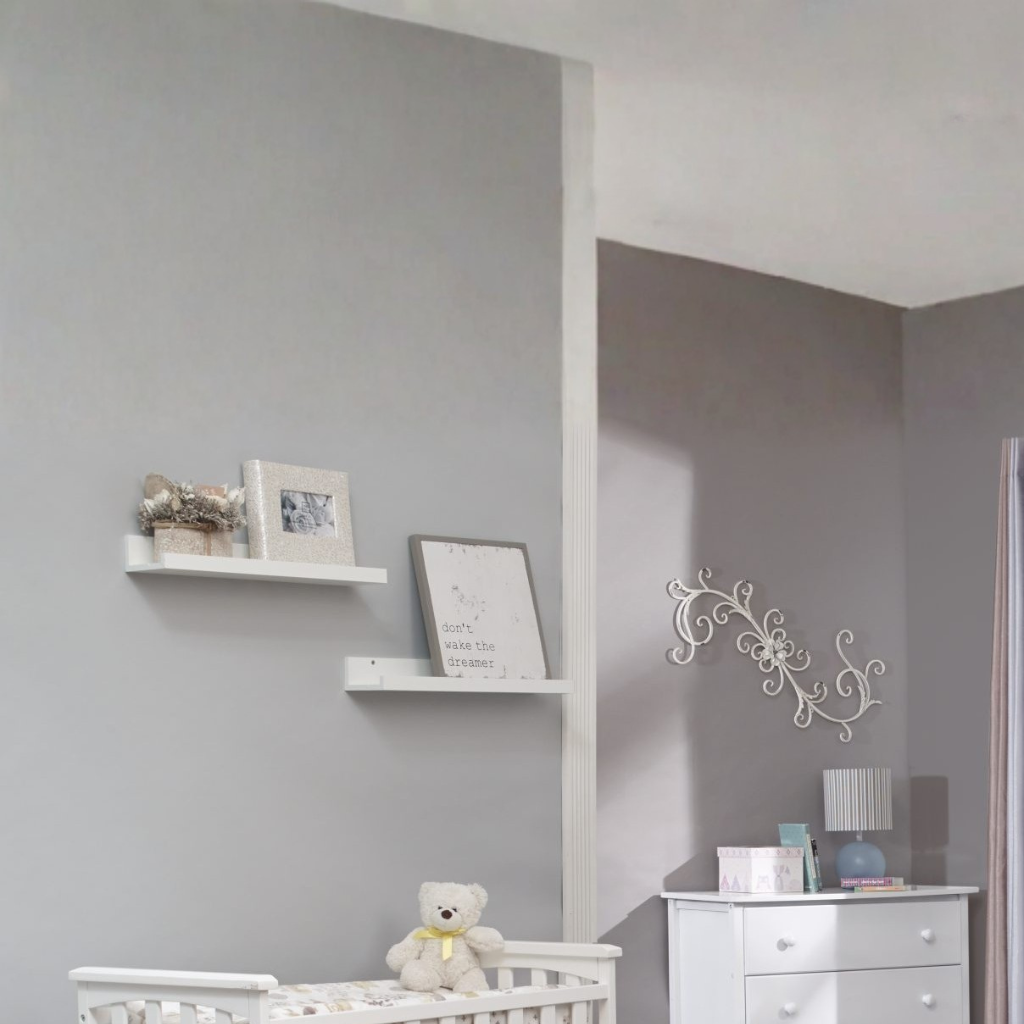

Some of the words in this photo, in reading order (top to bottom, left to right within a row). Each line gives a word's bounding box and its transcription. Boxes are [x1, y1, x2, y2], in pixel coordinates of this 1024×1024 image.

[442, 621, 473, 634] don't
[444, 639, 472, 651] wake
[475, 640, 496, 652] the
[447, 656, 495, 668] dreamer
